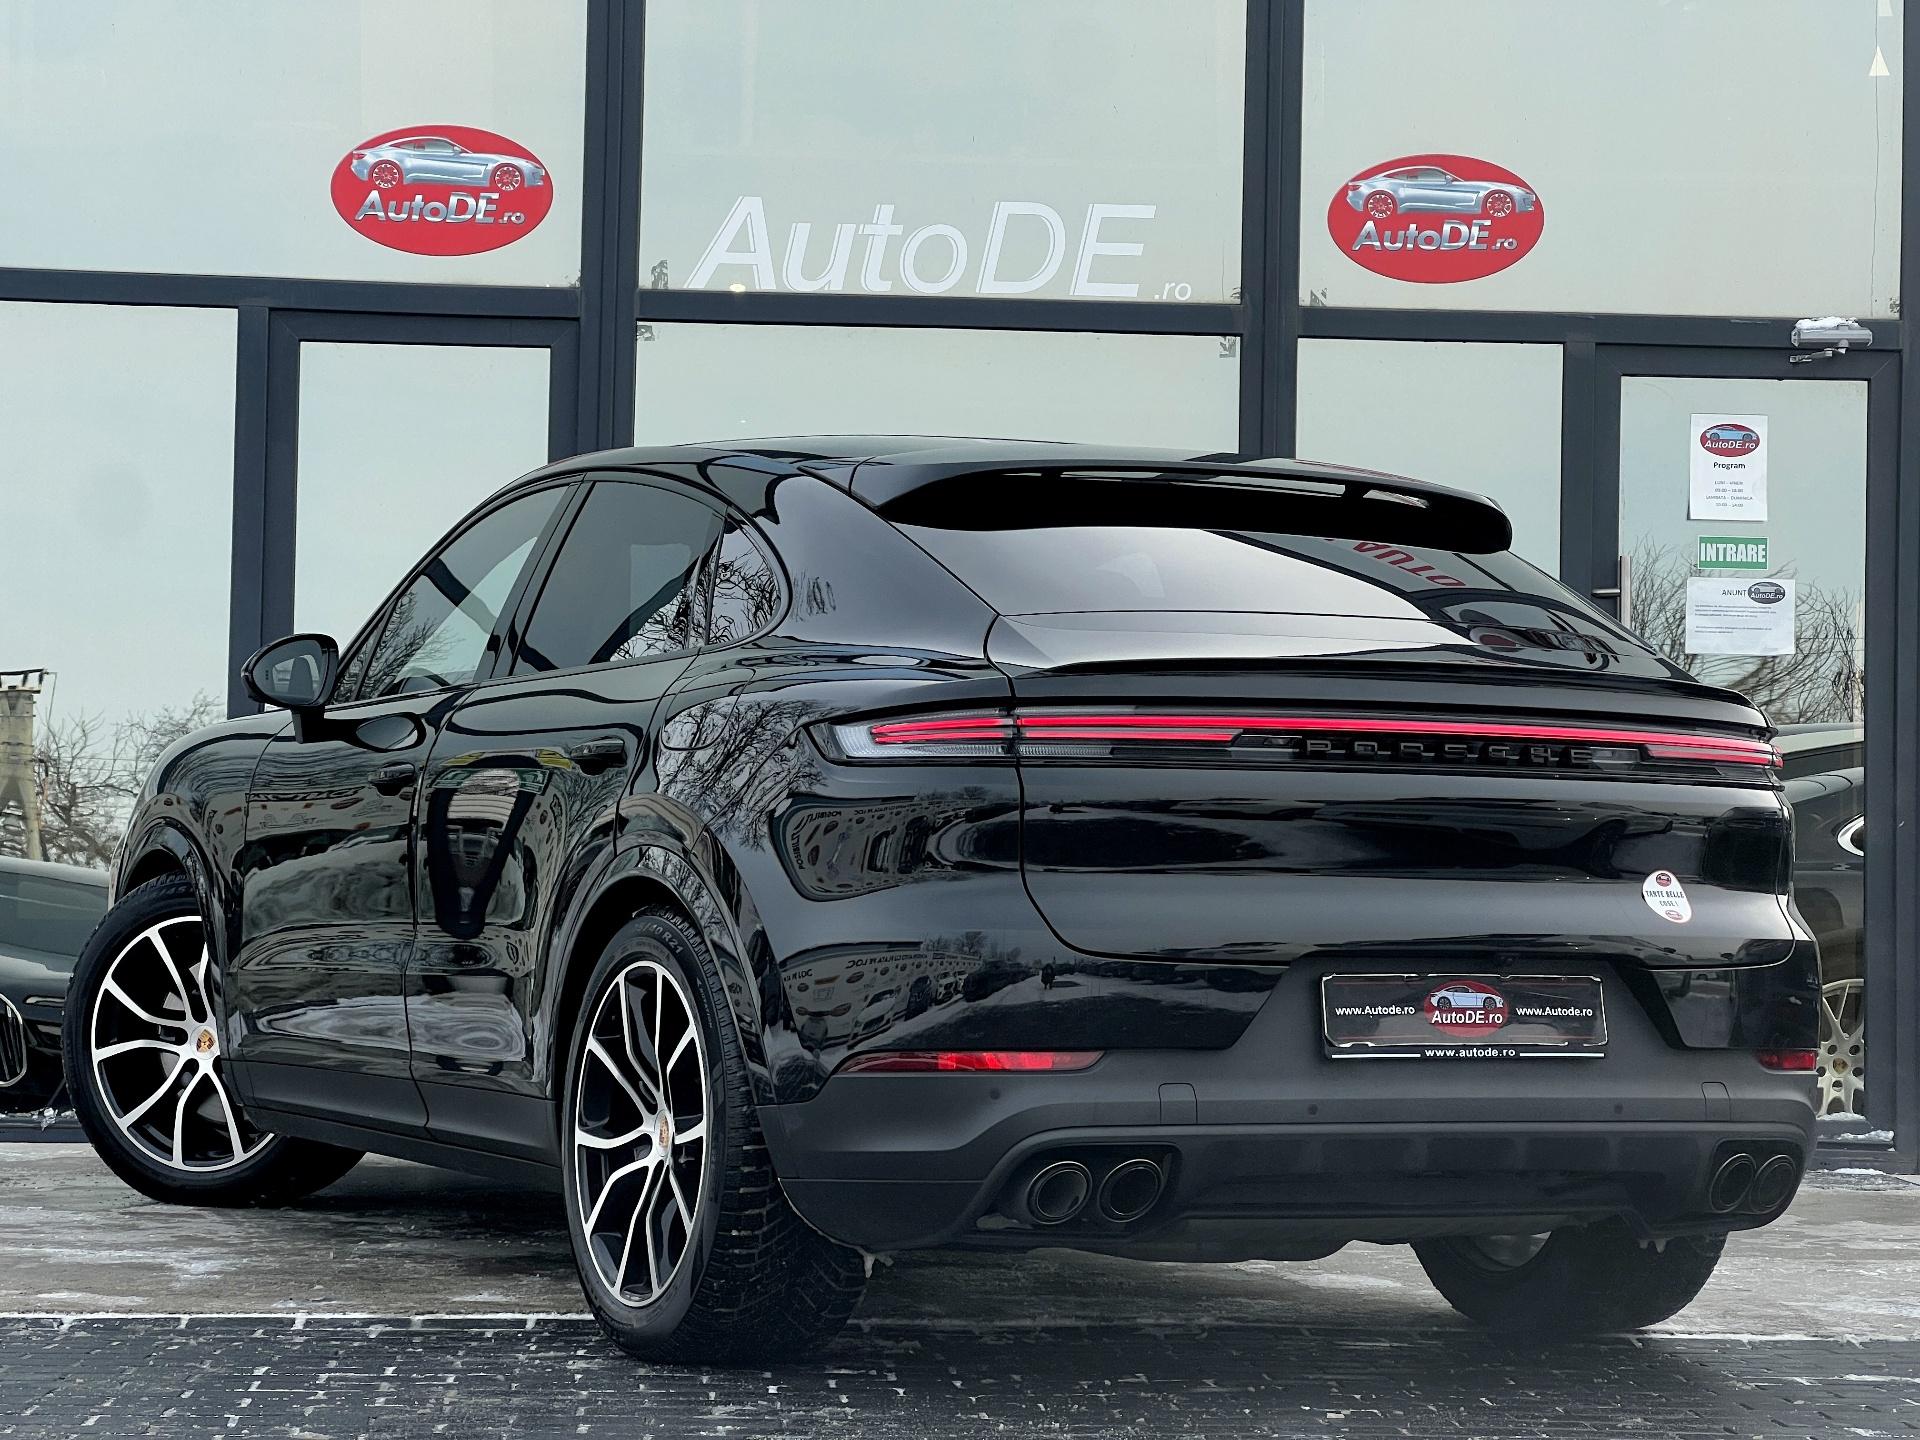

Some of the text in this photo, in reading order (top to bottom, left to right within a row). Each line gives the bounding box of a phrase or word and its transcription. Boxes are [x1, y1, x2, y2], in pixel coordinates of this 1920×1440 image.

[1704, 440, 1756, 449] AutoDE.ro
[1713, 461, 1746, 470] Program
[1700, 542, 1766, 563] INTRARE
[1306, 739, 1593, 765] PORSCHE
[1665, 890, 1685, 899] BELLE
[1334, 1004, 1594, 1026] www.Autode.ro AutoDE.ro www.Autode.ro
[1424, 1046, 1516, 1058] www.autode.ro
